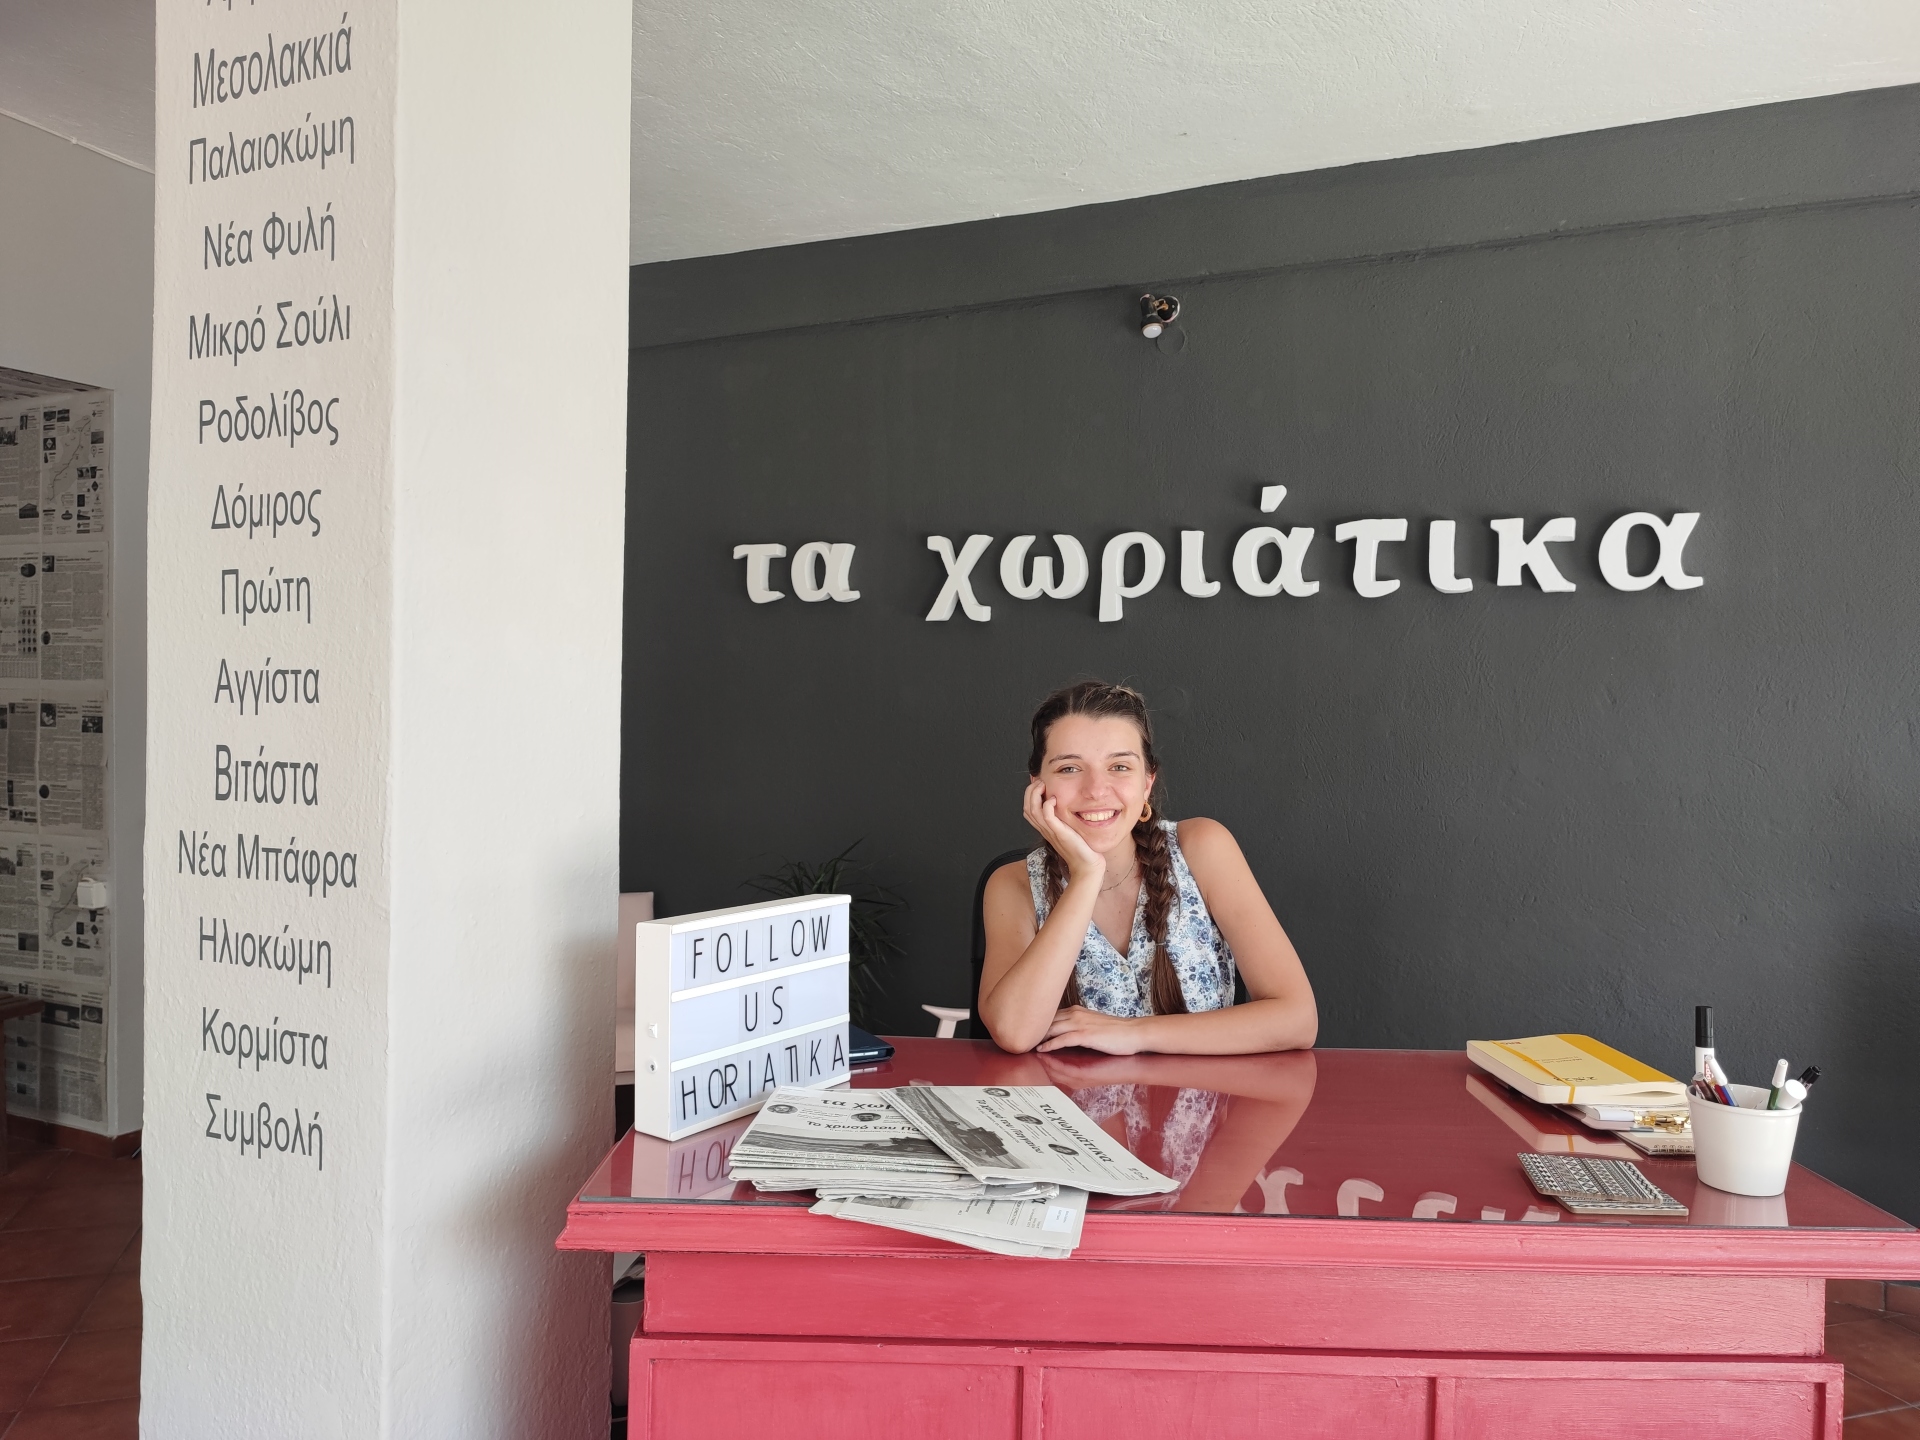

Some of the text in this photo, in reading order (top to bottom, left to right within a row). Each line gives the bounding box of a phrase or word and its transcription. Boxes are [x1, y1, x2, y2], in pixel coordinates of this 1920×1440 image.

[194, 12, 351, 108] Μεσολακκιά
[189, 112, 355, 184] Παλαιοκώμη
[204, 202, 335, 269] Νέα Φυλή
[189, 294, 350, 366] Μικρό Σούλι
[199, 389, 339, 448] Ροδολίβος
[211, 483, 321, 539] Δόμιρος
[733, 485, 1703, 622] τα χωριάτικα
[221, 567, 311, 626] Πρώτη
[214, 657, 320, 715] Αγγίστα
[215, 745, 319, 805] Βιτάστα
[178, 830, 357, 898] Νέα Μπάφρα
[199, 916, 332, 988] Ηλιοκώμη
[693, 914, 831, 979] FOLLOW
[202, 1007, 328, 1072] Κορμίστα
[744, 985, 784, 1032] US
[205, 1093, 323, 1171] Συμβολή
